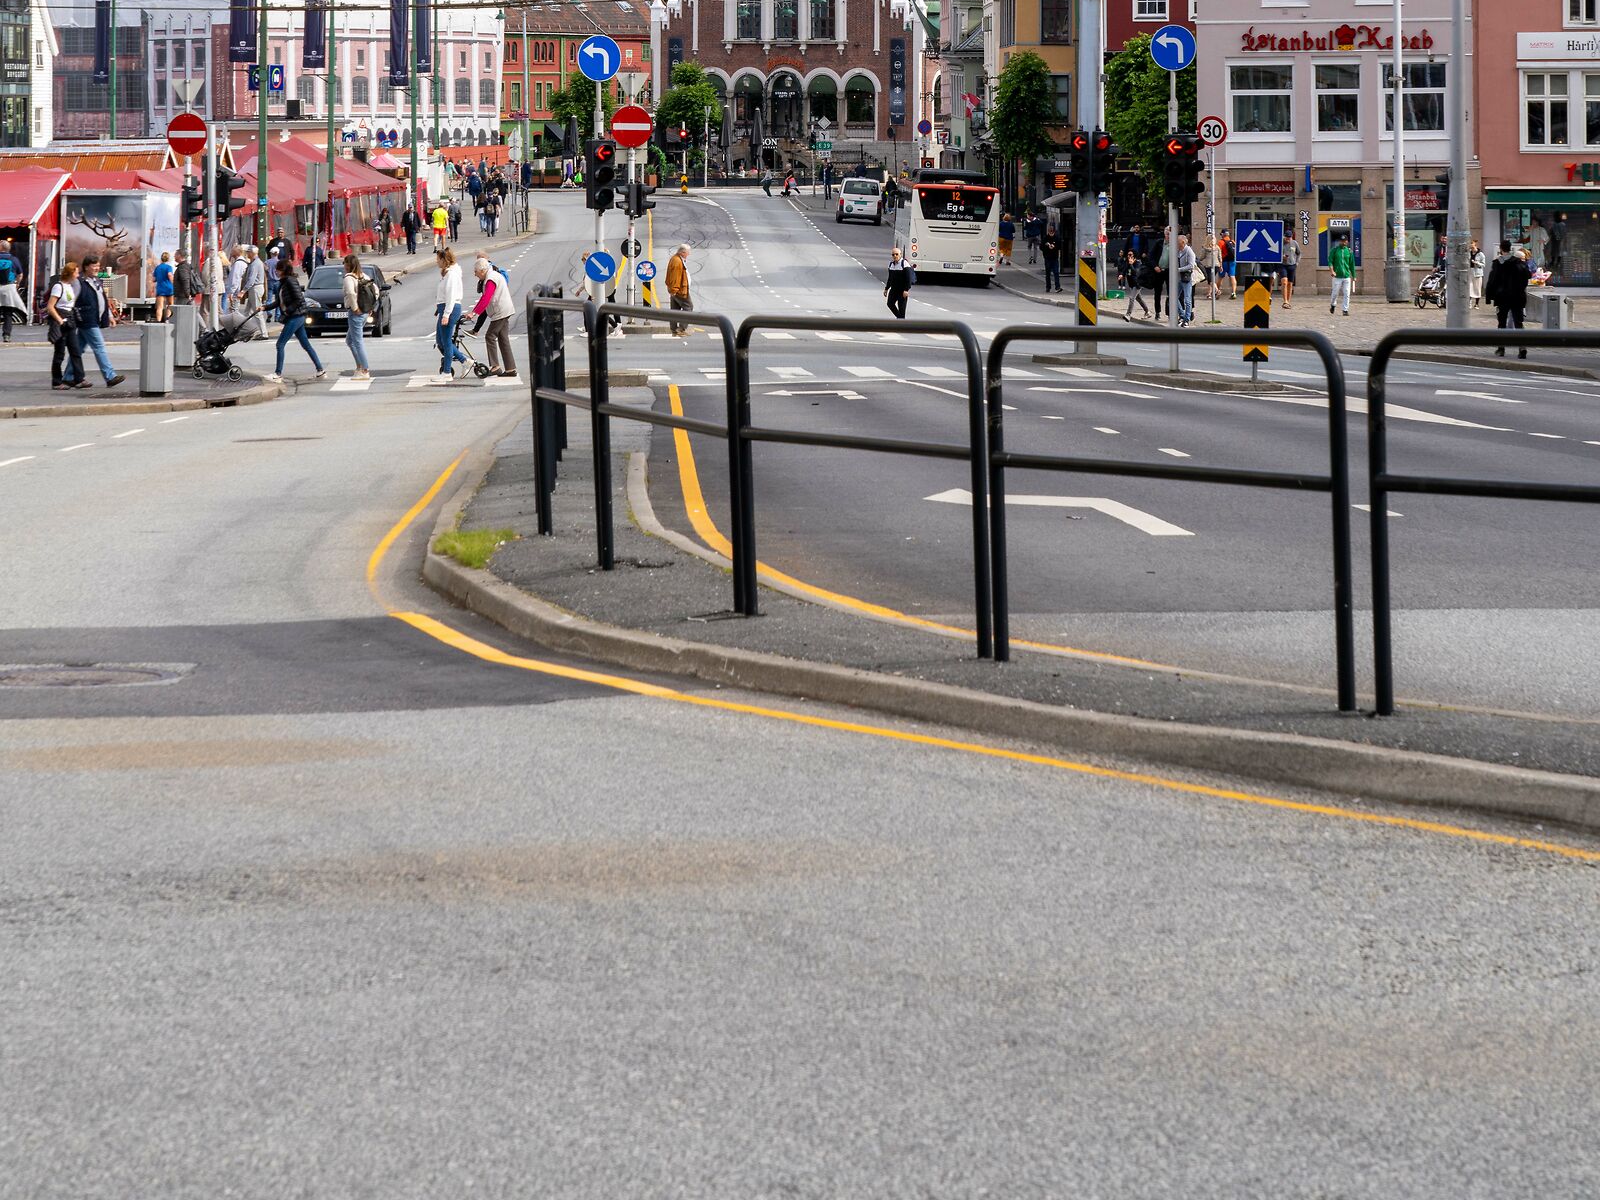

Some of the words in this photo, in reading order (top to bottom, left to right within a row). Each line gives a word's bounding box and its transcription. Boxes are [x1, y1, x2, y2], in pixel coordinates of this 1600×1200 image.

[1203, 123, 1222, 139] 30
[952, 191, 961, 201] 12
[1299, 210, 1311, 246] Kebab
